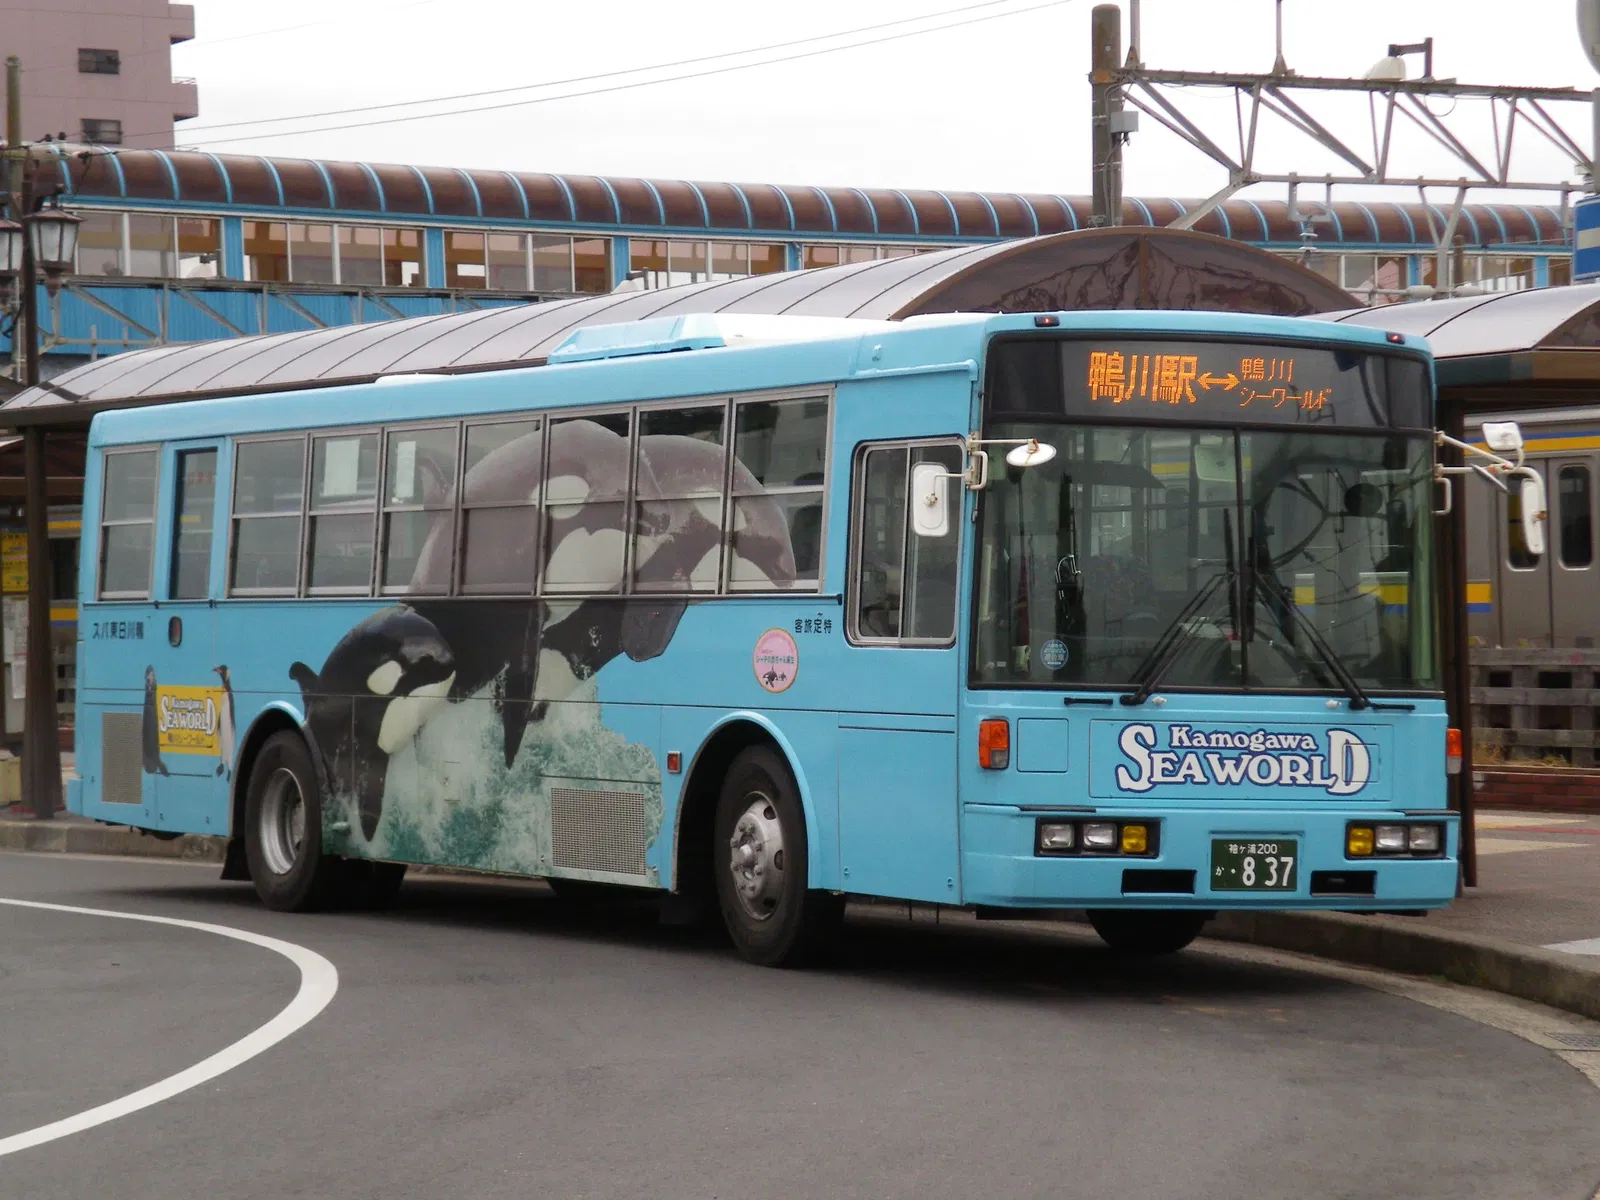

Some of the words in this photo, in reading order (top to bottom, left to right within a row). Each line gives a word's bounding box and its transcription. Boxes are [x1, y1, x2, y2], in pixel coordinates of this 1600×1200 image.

[1088, 351, 1197, 404] 鴨川駅
[1241, 357, 1294, 382] 鴨川
[1239, 387, 1333, 409] シーワールド
[1168, 724, 1319, 752] Kamogawa
